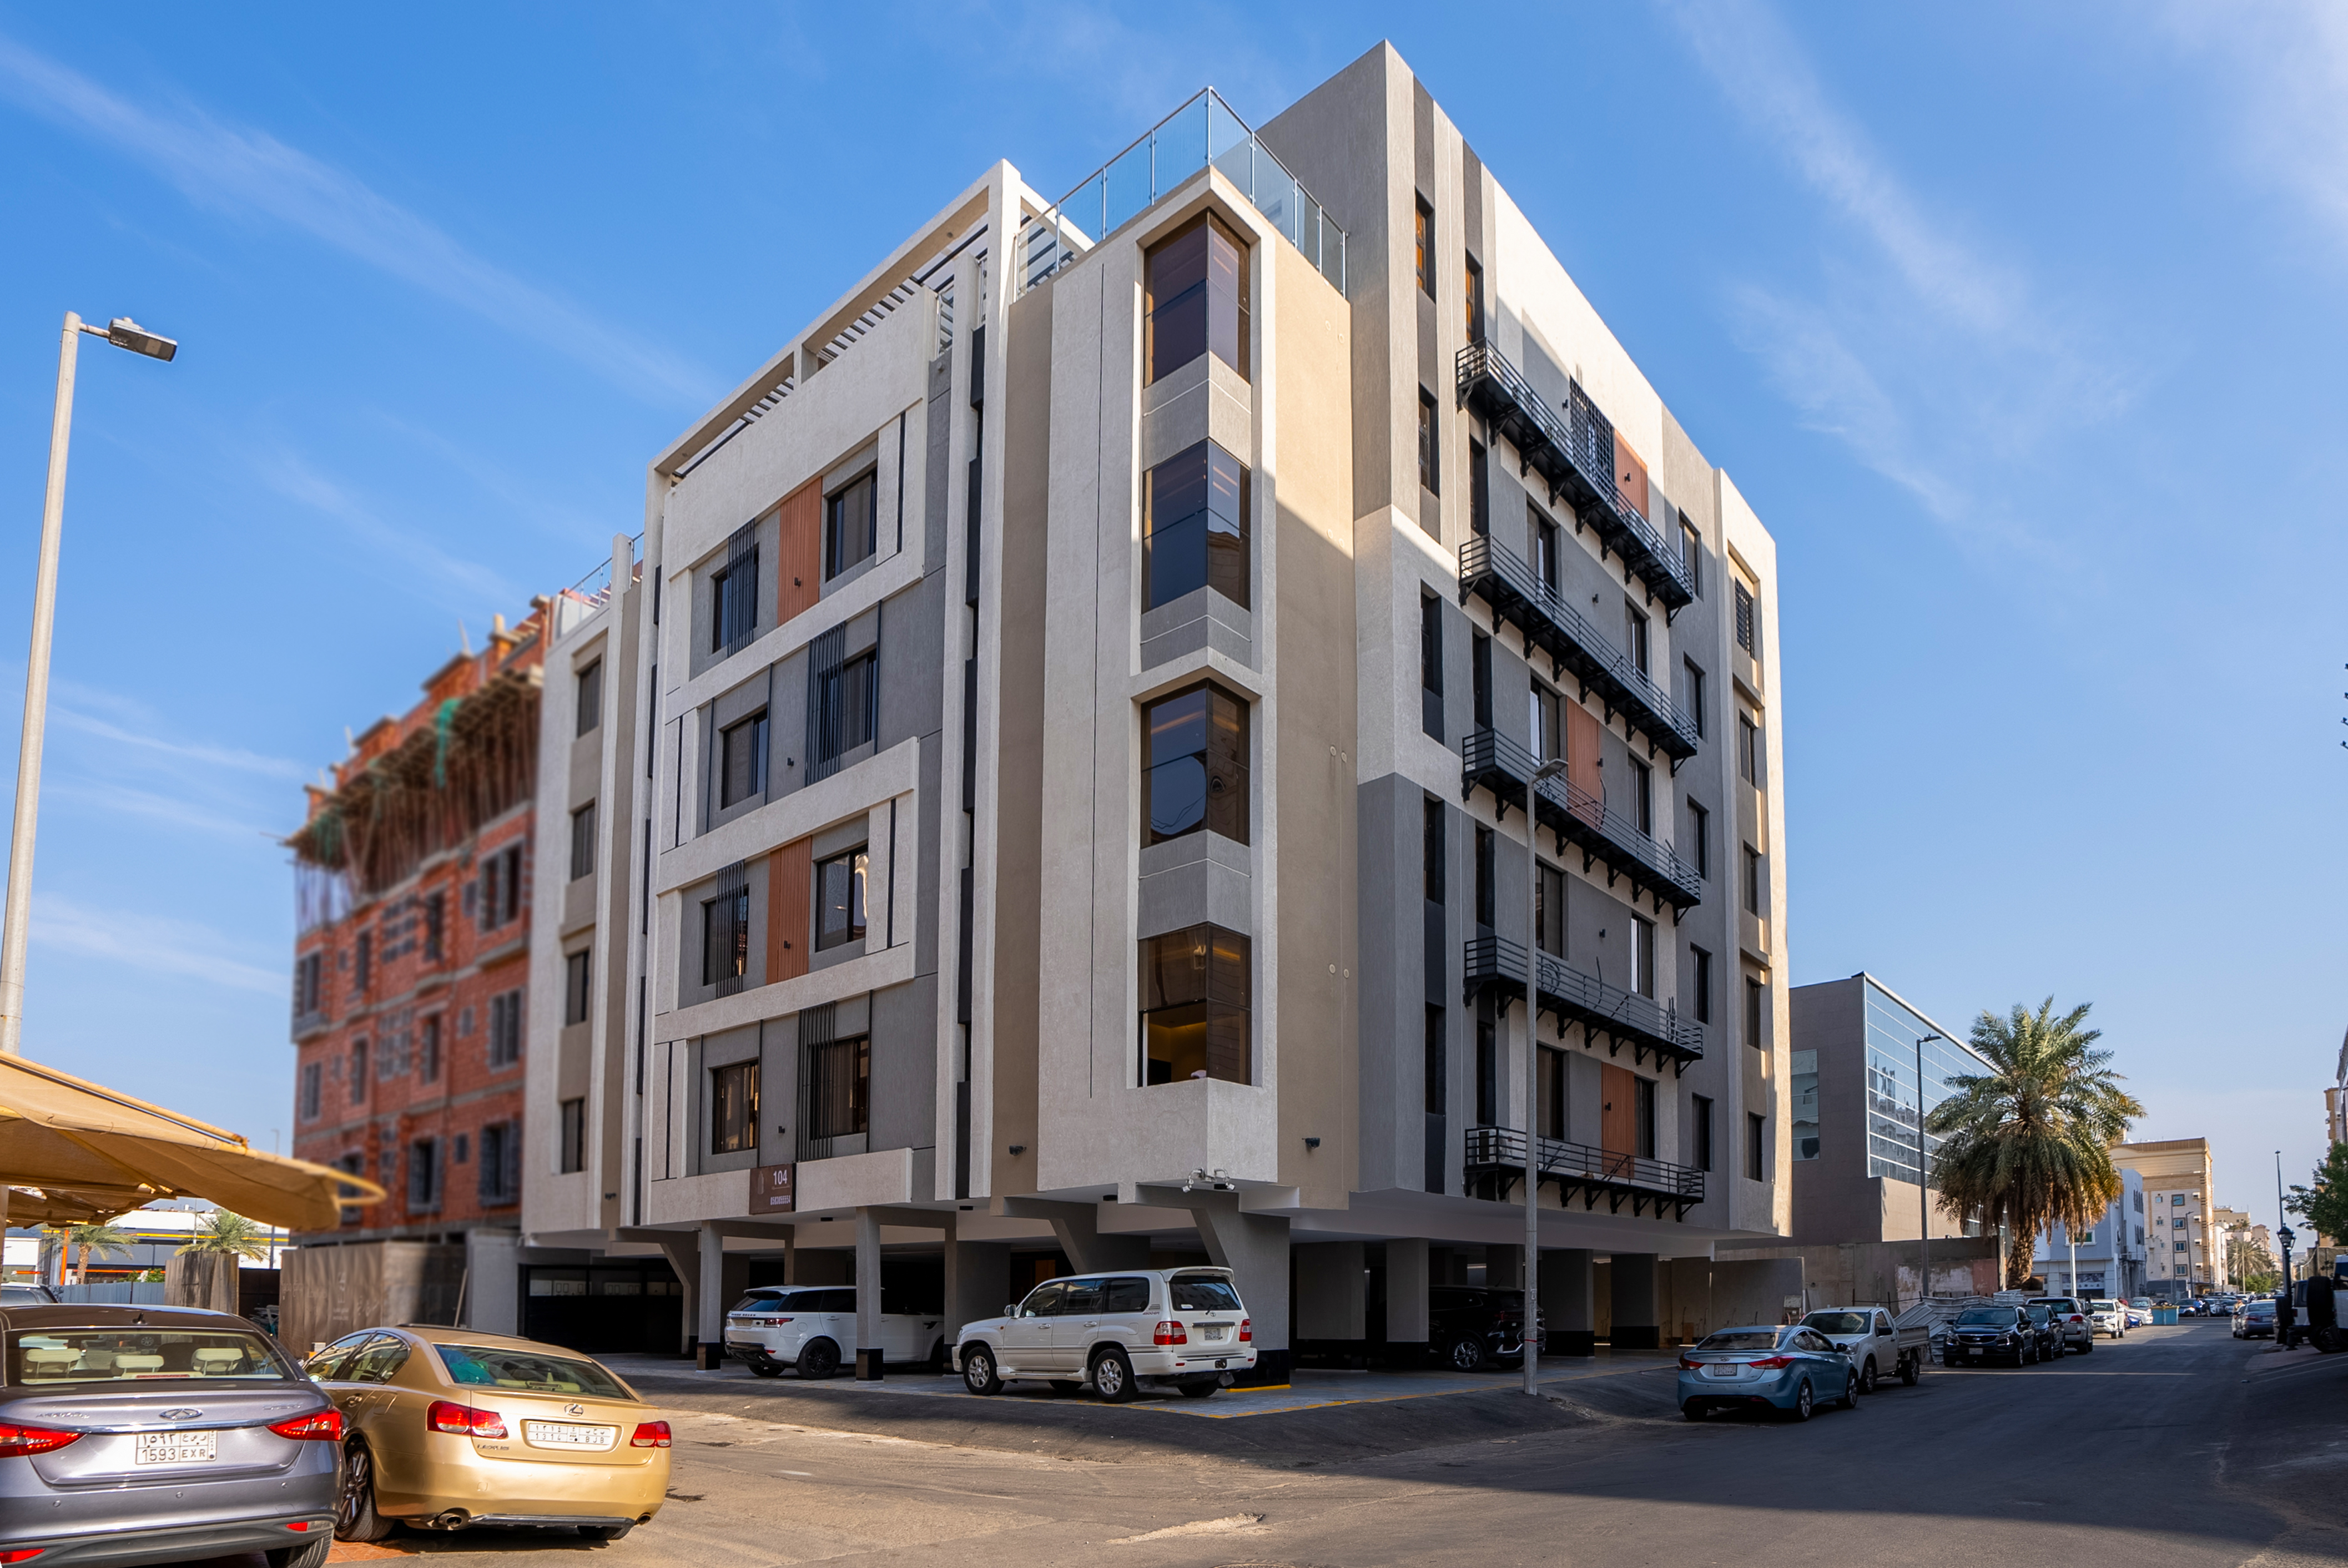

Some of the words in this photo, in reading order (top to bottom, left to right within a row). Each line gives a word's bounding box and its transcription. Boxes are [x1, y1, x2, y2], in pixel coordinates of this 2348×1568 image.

[773, 1169, 787, 1185] 104
[142, 1448, 175, 1461] 1593
[182, 1449, 205, 1458] EXR
